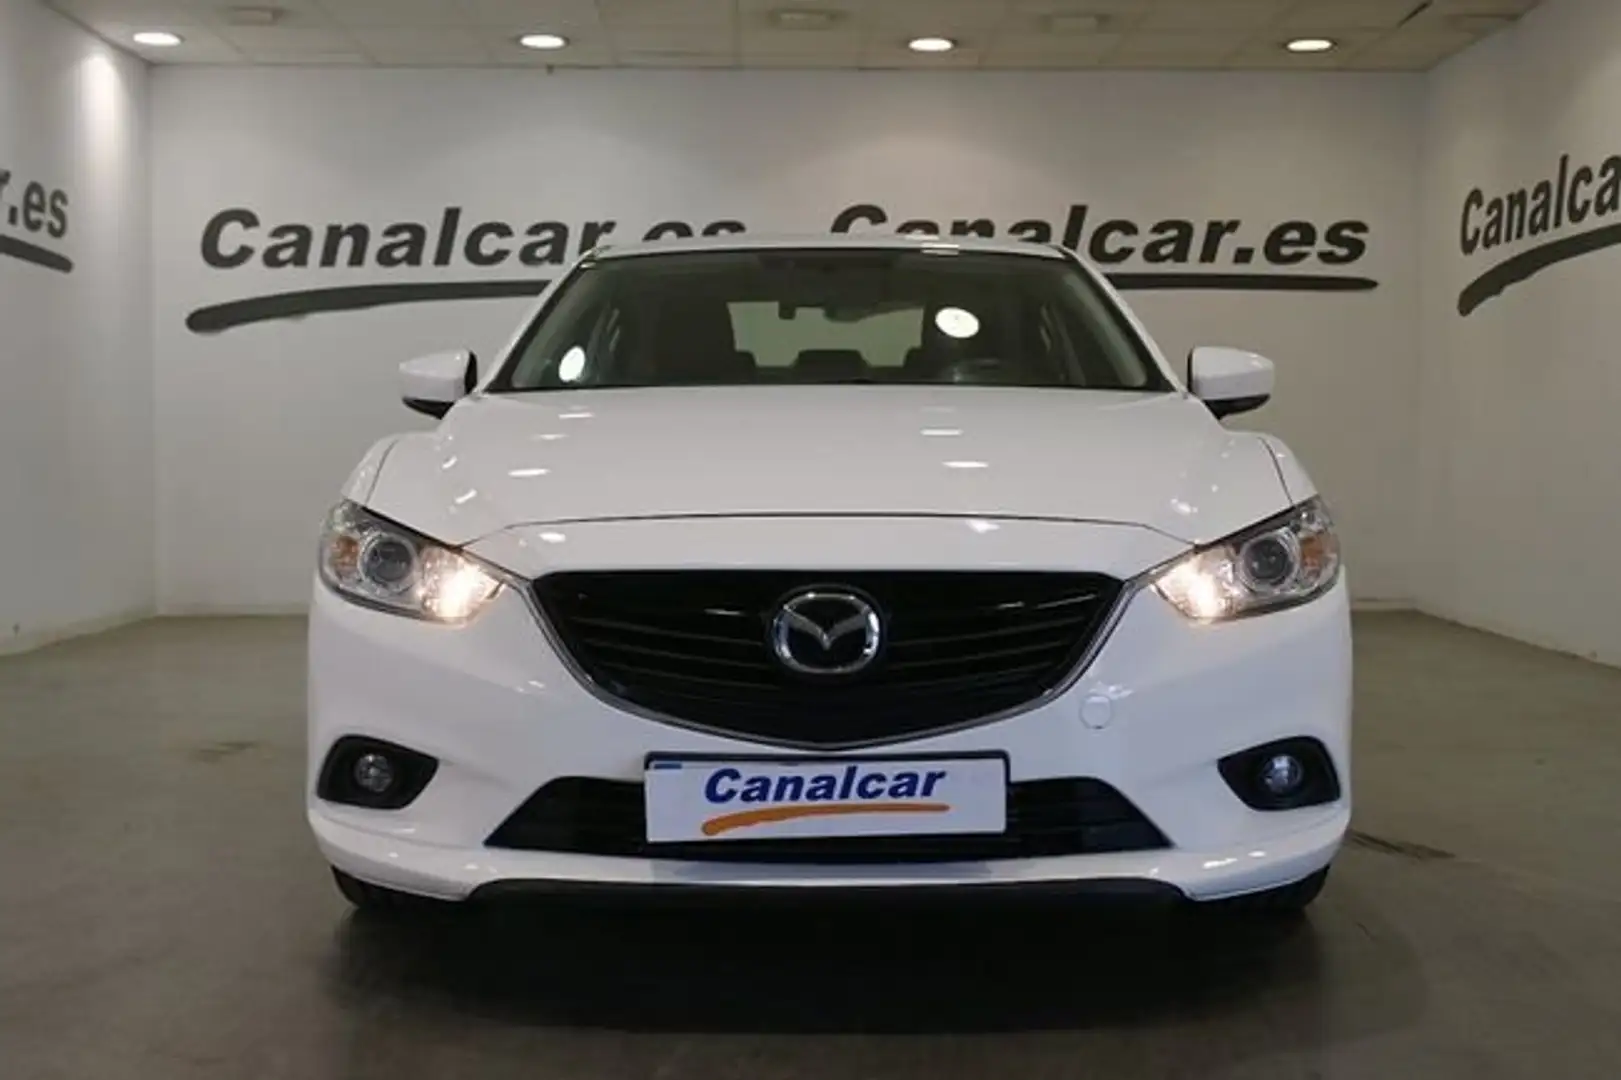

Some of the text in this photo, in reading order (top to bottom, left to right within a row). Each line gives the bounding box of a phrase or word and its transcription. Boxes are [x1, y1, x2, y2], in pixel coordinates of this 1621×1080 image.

[1460, 154, 1621, 256] Canalca
[201, 207, 747, 269] Canalcar
[704, 765, 946, 804] Canalcar
